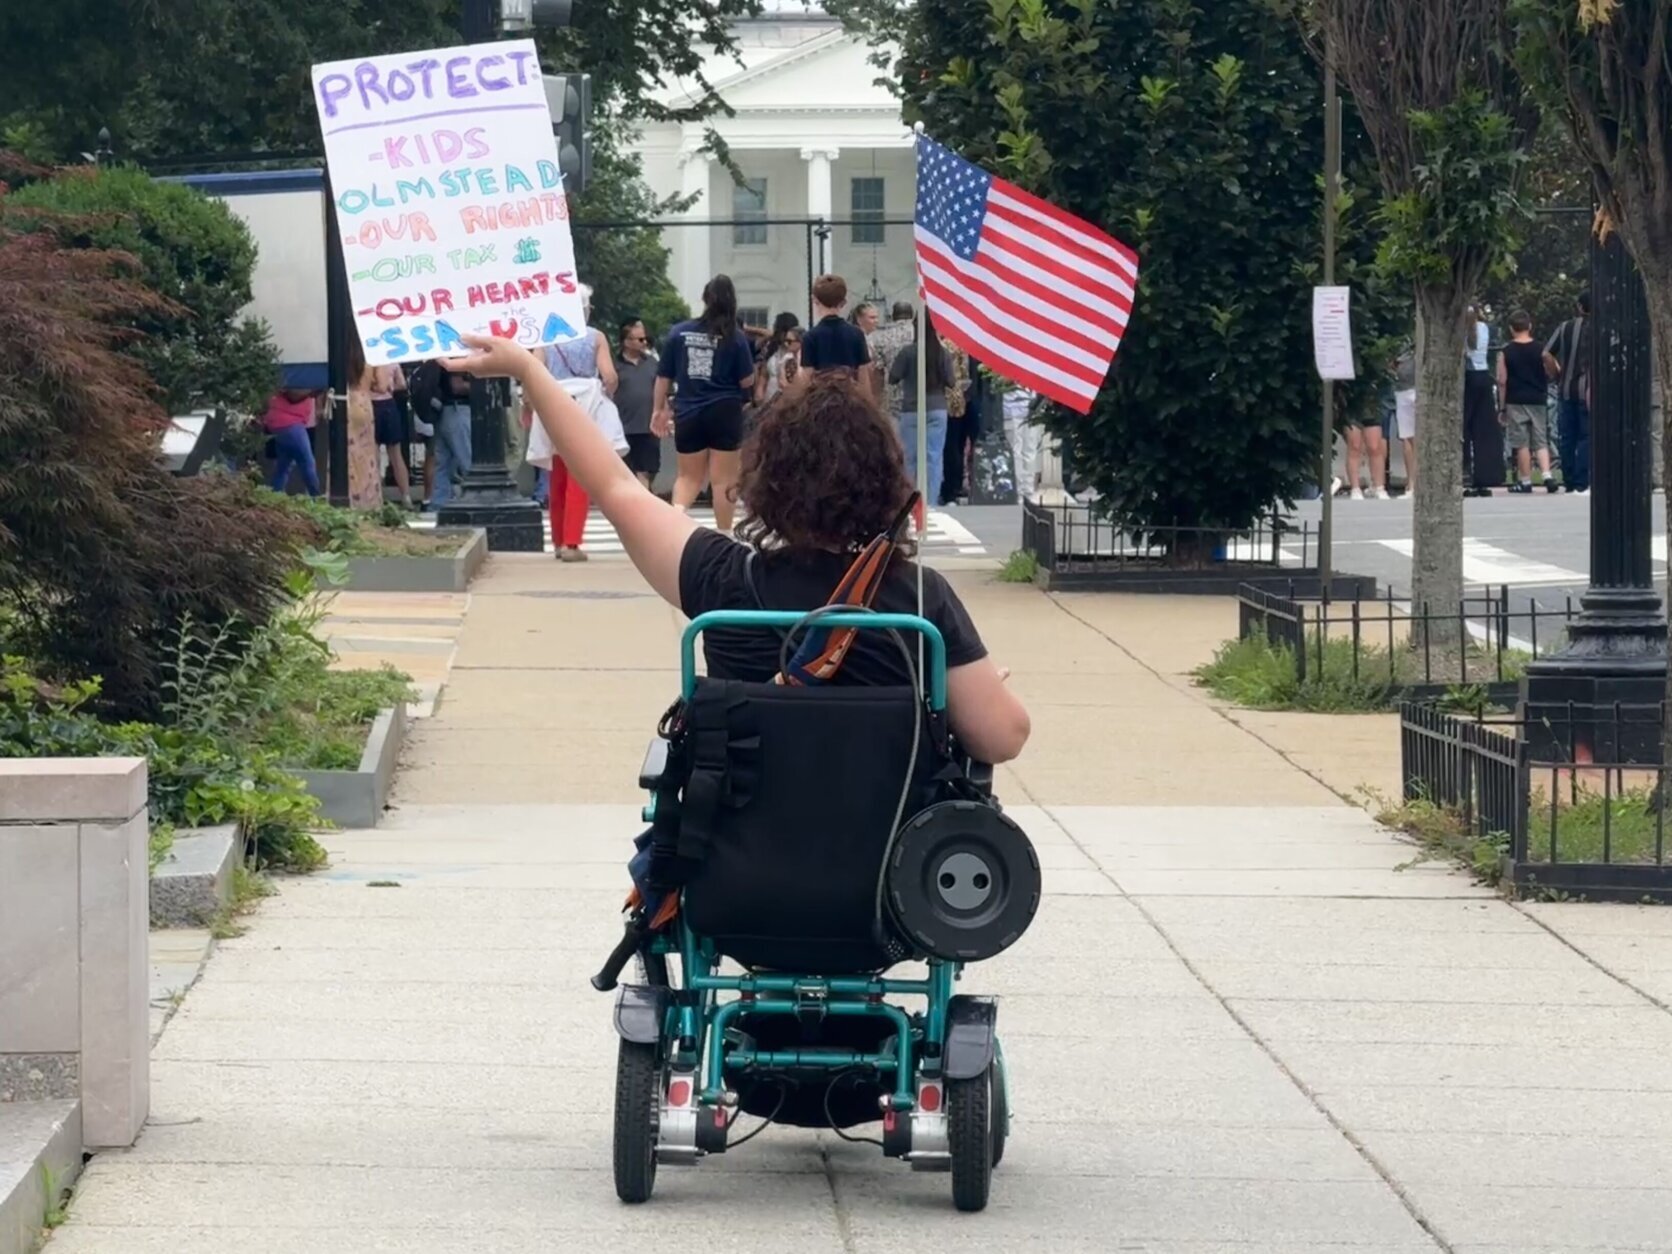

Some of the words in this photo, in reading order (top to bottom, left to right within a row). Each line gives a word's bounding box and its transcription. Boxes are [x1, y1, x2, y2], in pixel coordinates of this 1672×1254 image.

[459, 193, 568, 235] RIGHTS
[447, 243, 497, 270] TAX
[513, 236, 541, 264] $
[467, 271, 577, 307] HEARTS
[489, 312, 578, 344] USA
